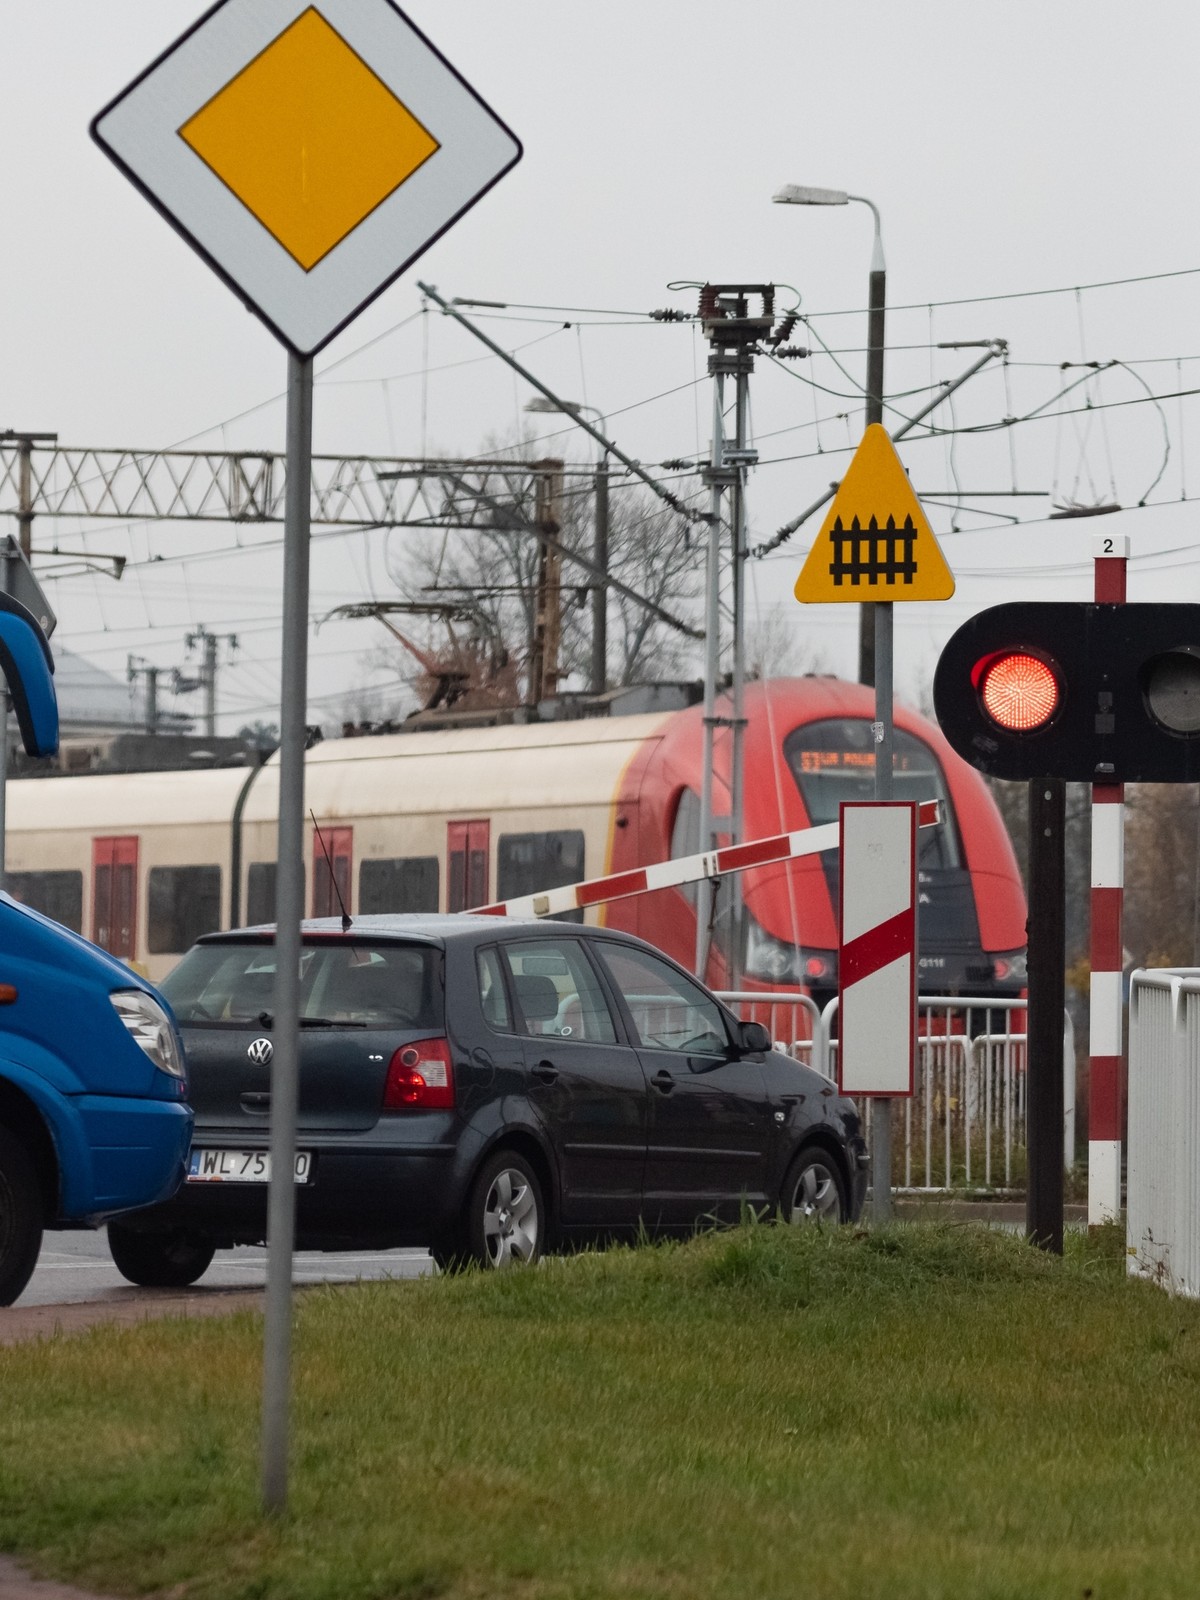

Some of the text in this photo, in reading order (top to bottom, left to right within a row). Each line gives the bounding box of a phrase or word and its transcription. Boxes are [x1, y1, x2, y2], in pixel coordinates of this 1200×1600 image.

[1103, 538, 1113, 553] 2
[203, 1151, 308, 1176] WL 750
